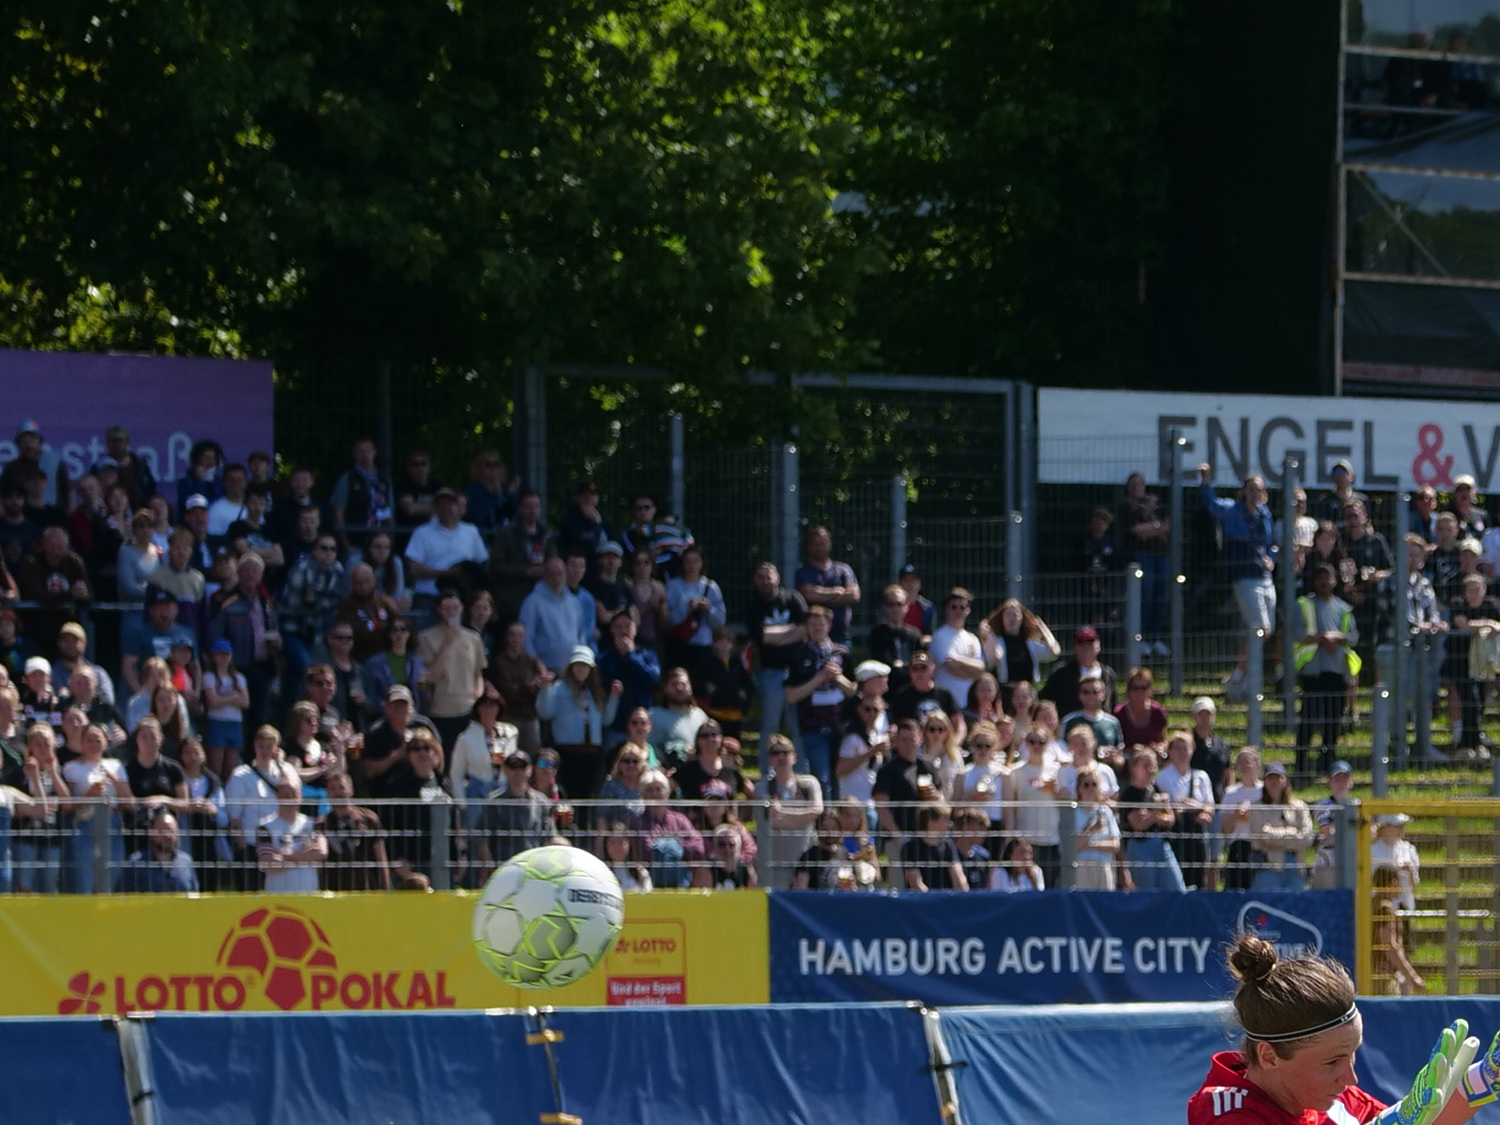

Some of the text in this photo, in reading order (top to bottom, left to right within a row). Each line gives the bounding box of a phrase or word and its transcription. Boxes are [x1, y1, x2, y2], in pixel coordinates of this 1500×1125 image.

[1157, 415, 1399, 485] ENGEL
[1412, 422, 1454, 488] &
[633, 938, 677, 953] LOTTO
[800, 936, 1211, 975] HAMBURG ACTIVE CITY
[115, 971, 456, 1013] LOTTO POKAL
[651, 980, 682, 997] Sport
